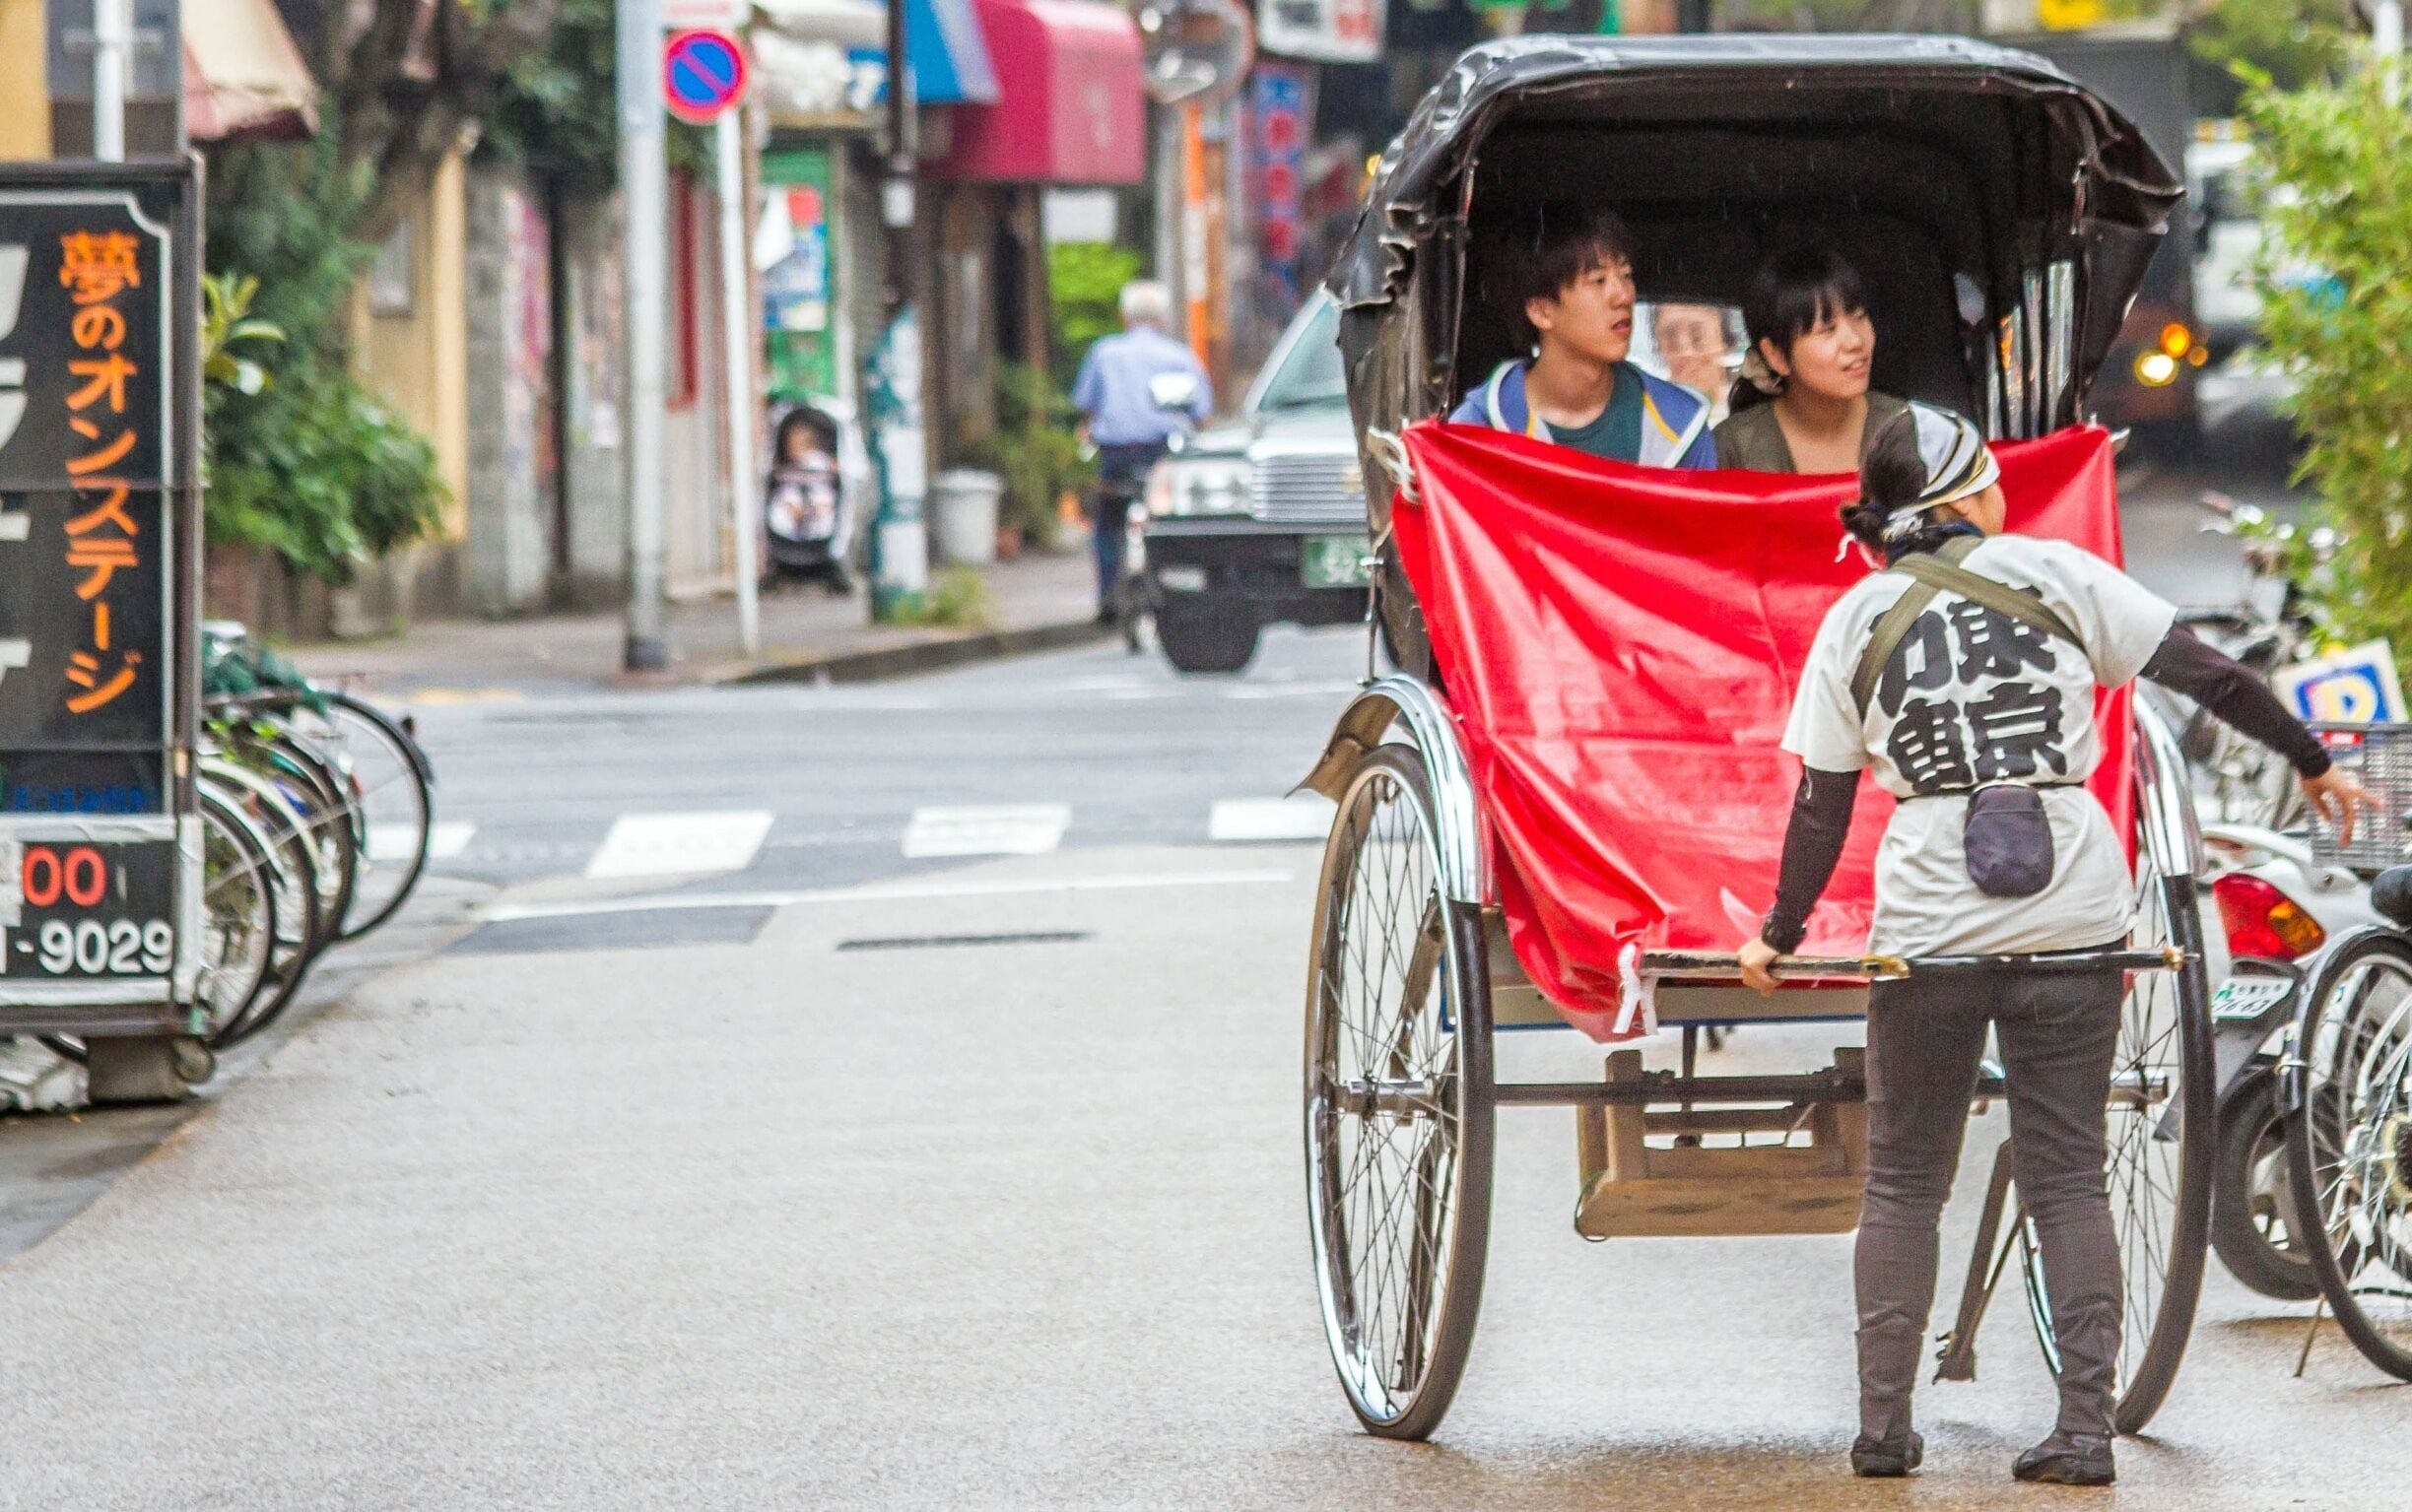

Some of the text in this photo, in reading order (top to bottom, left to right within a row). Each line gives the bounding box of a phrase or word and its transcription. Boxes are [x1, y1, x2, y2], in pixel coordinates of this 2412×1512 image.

[58, 230, 143, 713] 夢のオンステージ
